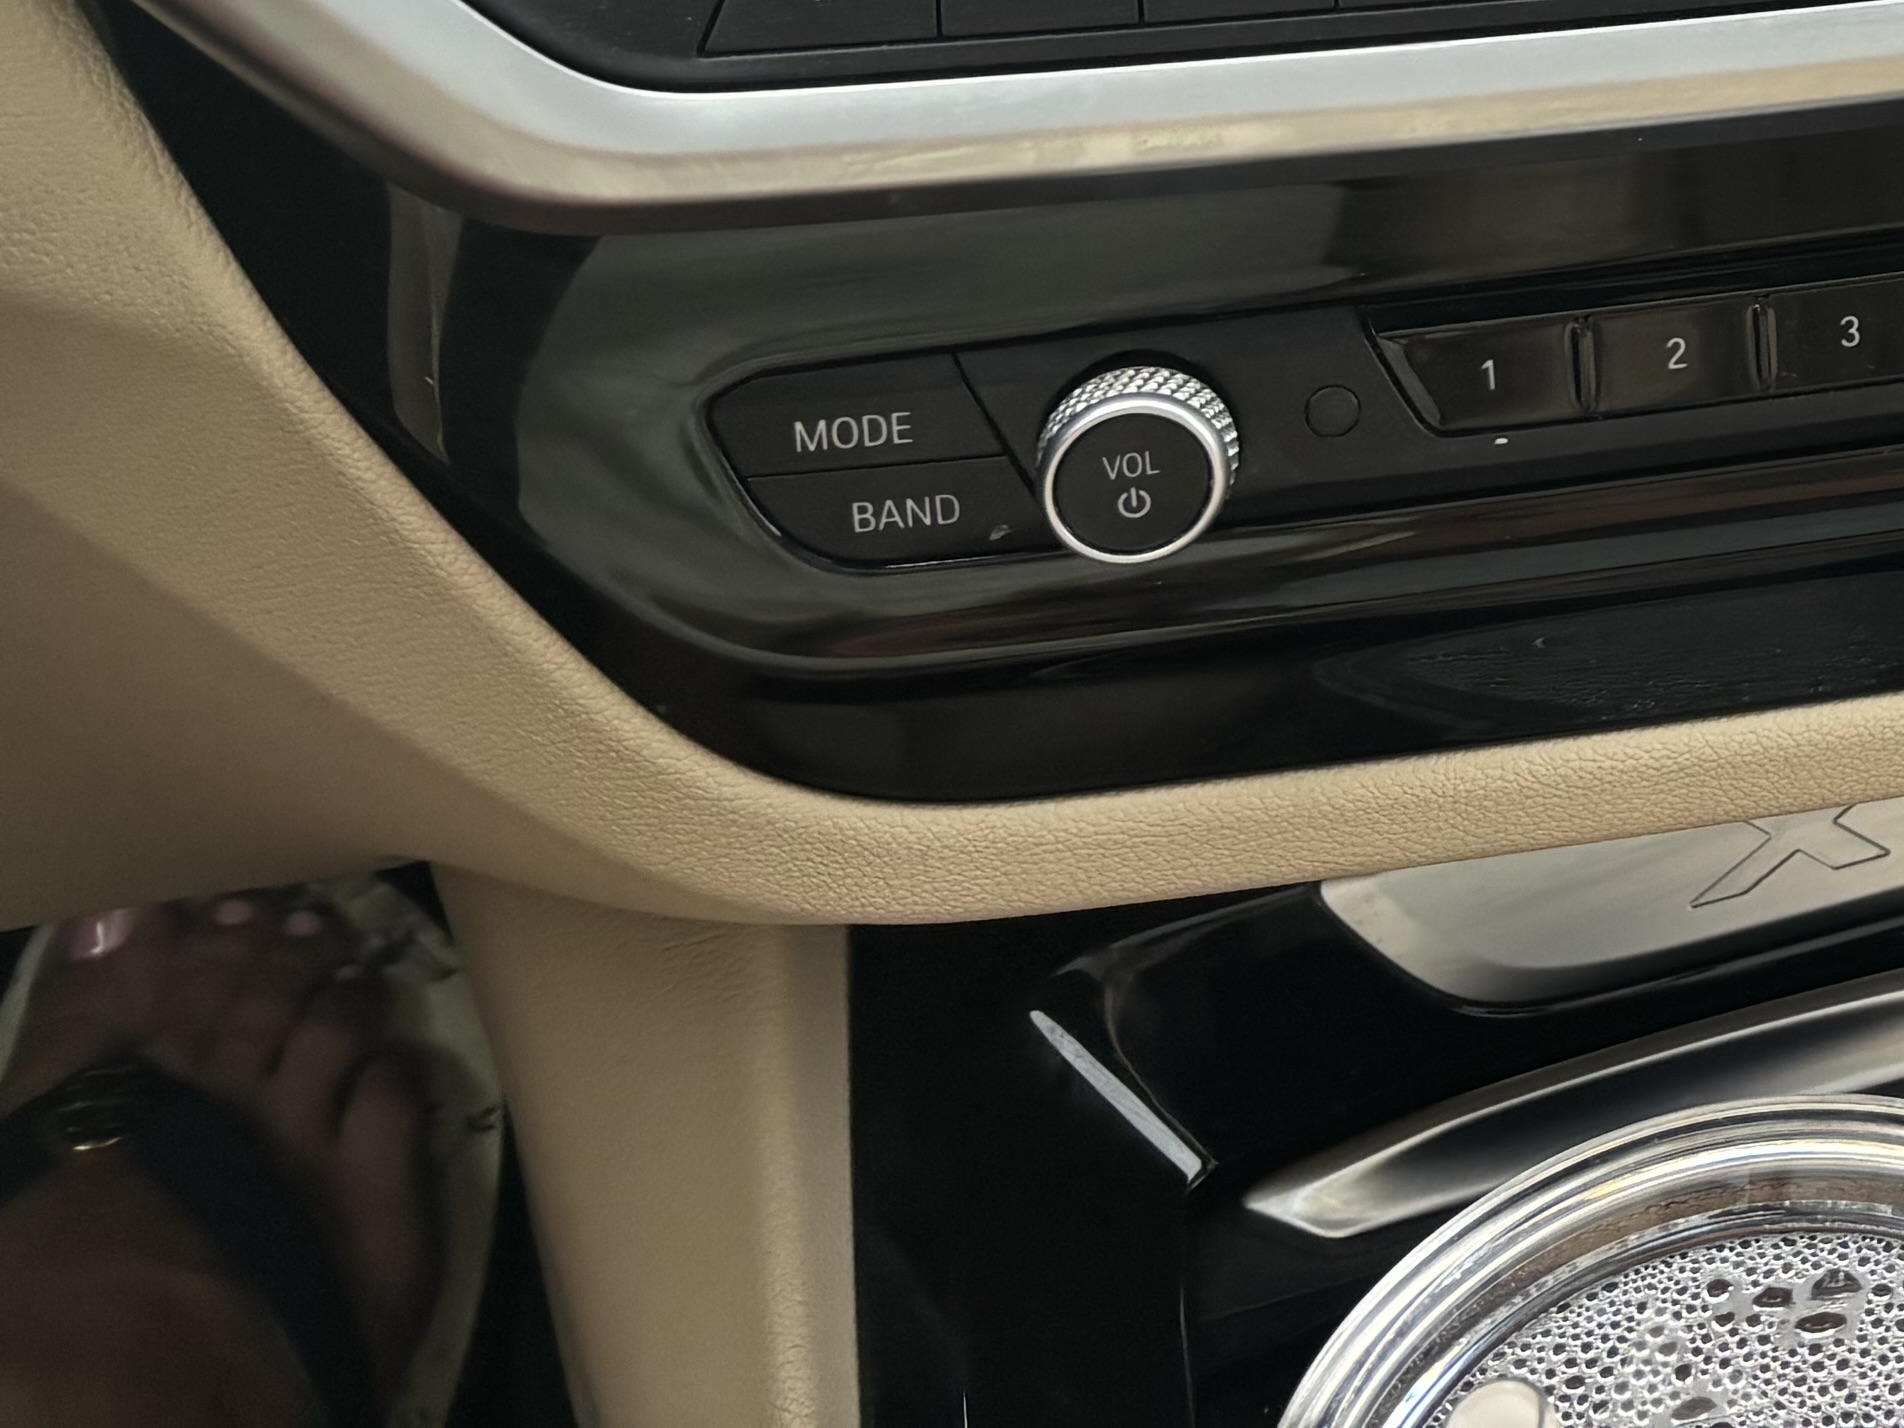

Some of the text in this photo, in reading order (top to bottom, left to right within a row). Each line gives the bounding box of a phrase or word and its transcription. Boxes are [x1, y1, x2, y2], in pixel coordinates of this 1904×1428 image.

[1840, 315, 1860, 347] 3
[1666, 337, 1687, 370] 2
[1481, 359, 1495, 390] 1
[794, 411, 914, 453] MODE
[1102, 450, 1161, 480] VOL
[852, 494, 960, 533] BAND
